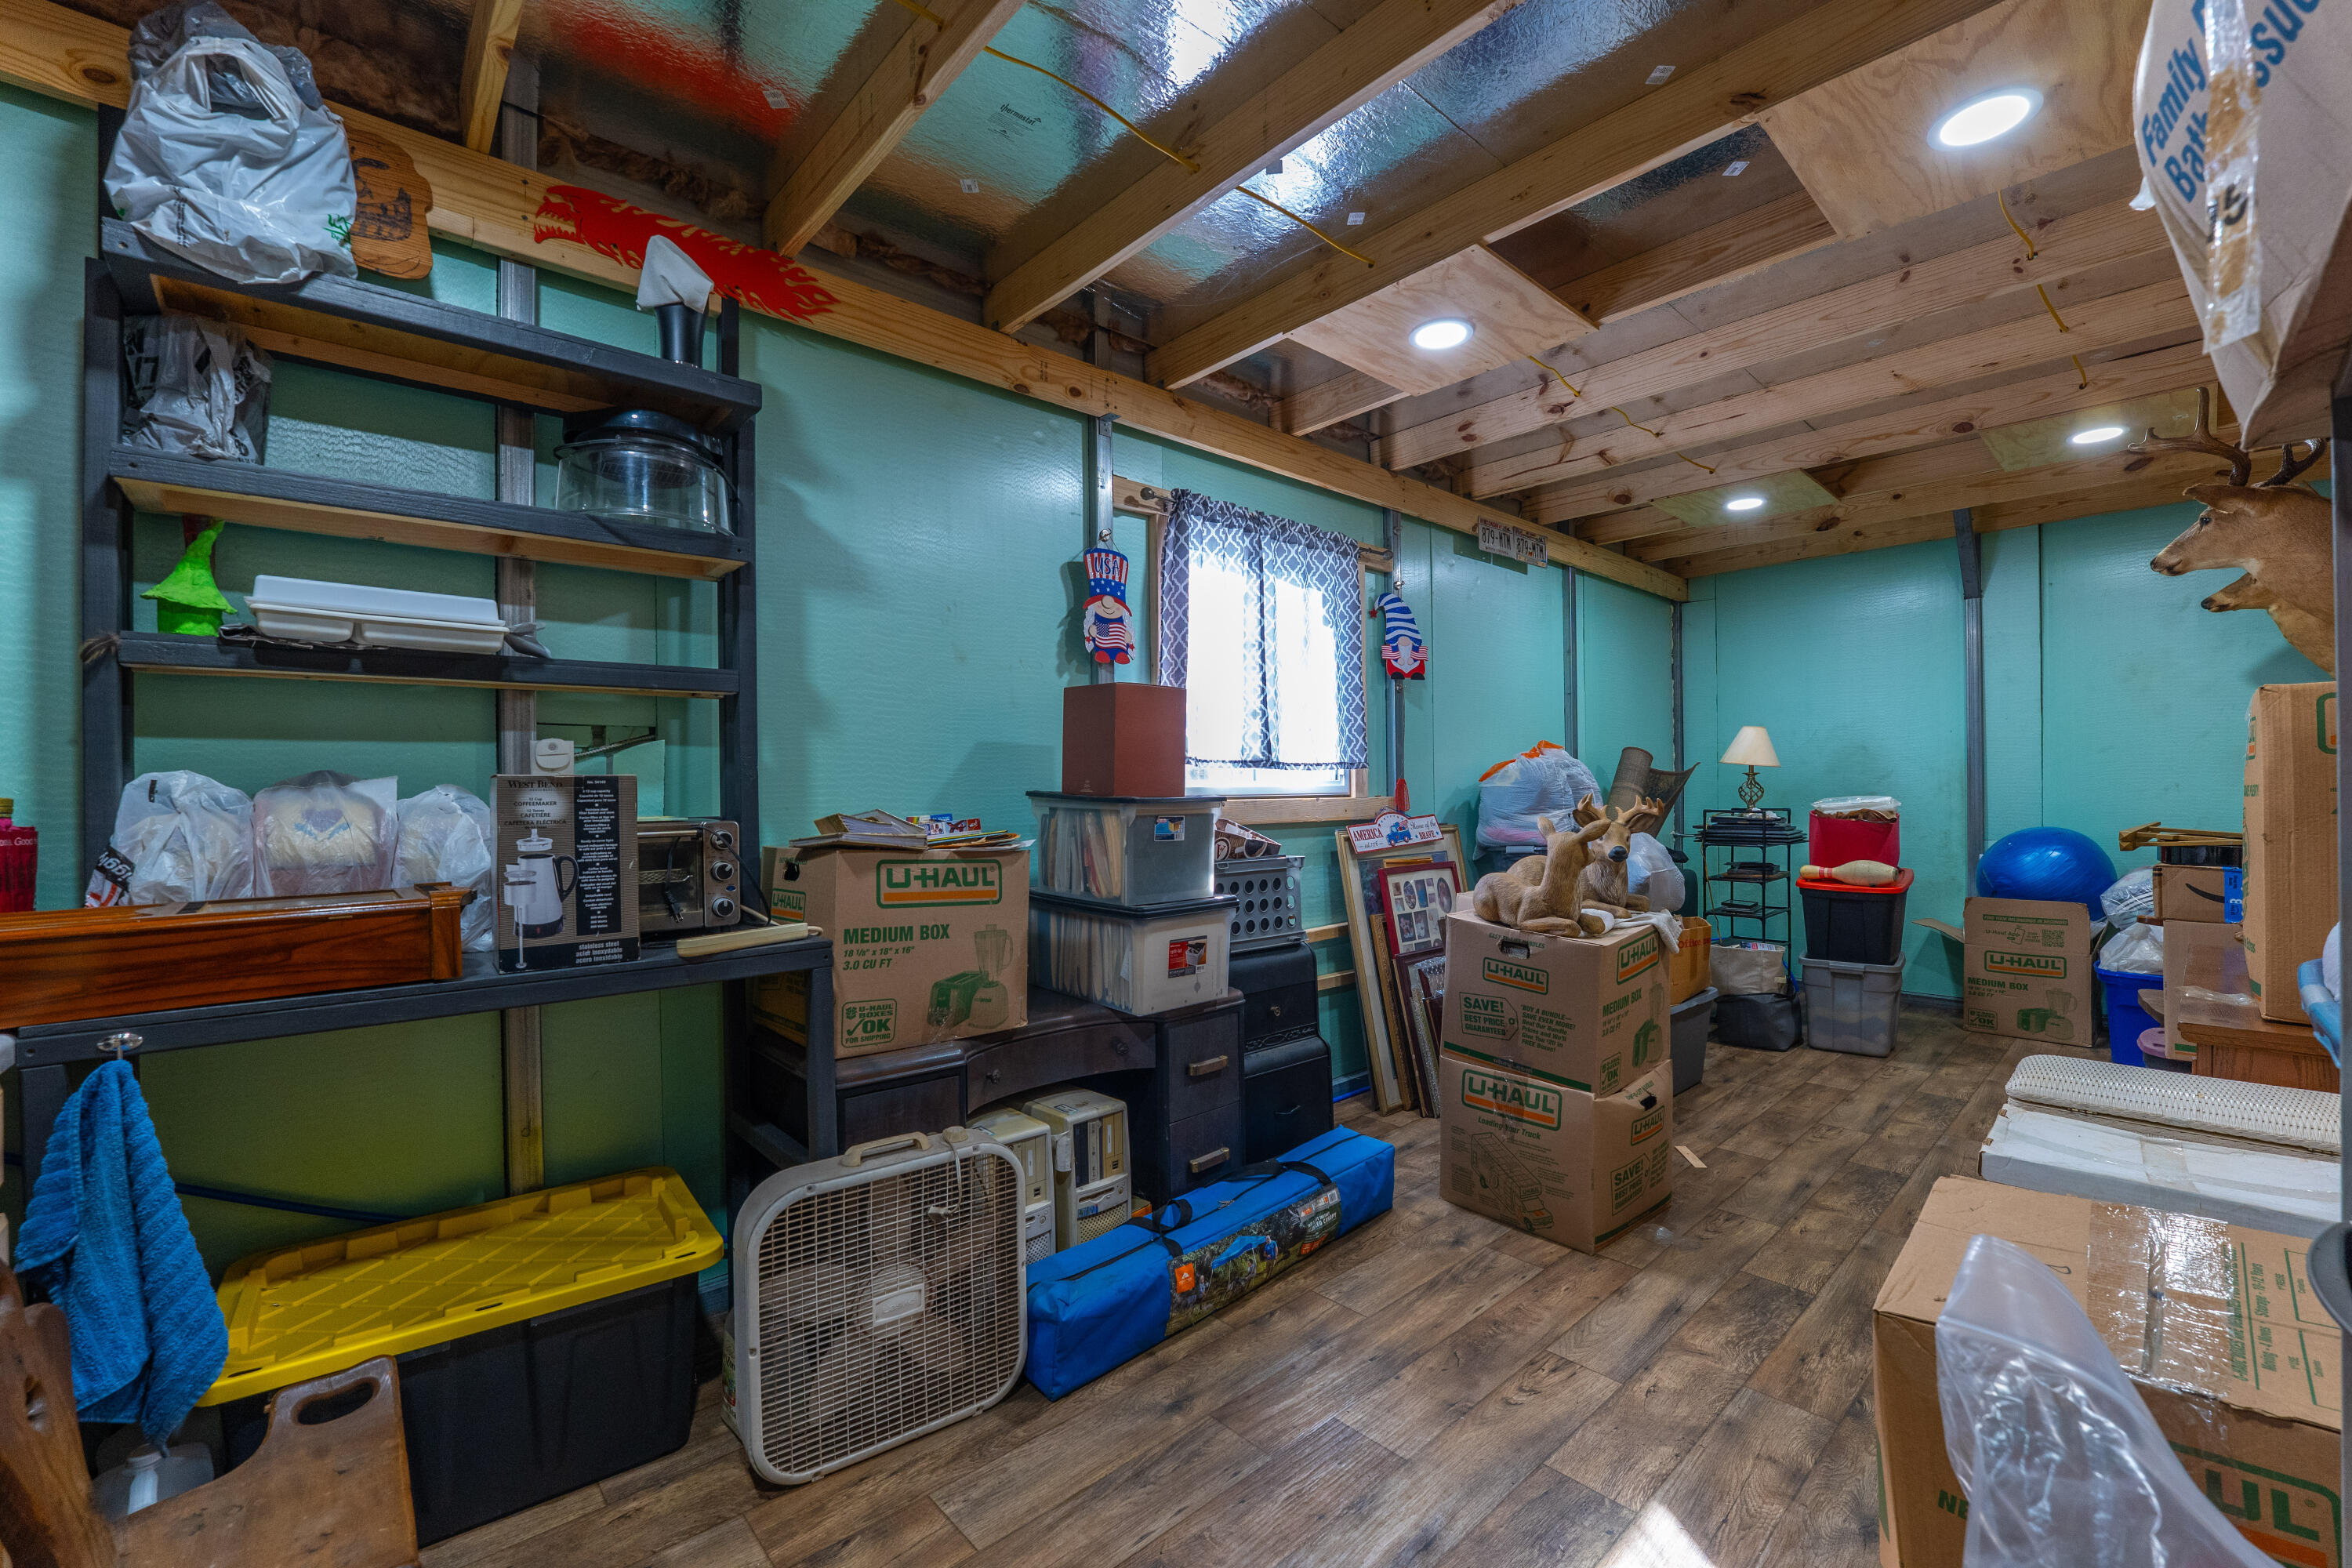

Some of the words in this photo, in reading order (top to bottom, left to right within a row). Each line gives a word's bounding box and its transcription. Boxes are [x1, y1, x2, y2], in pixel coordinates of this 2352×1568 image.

[2142, 38, 2206, 167] Family
[1094, 556, 1120, 576] USA
[508, 780, 534, 789] WEST
[1352, 827, 1385, 842] AMERICA
[1418, 829, 1436, 840] BRAVE
[886, 866, 995, 889] U-HAUL
[772, 892, 804, 911] U-HAUL
[844, 926, 914, 945] MEDIUM
[920, 924, 950, 940] BOX
[1621, 938, 1657, 969] U-HAUL
[1990, 954, 2062, 970] U-HAUL
[843, 960, 860, 971] 3.0
[862, 959, 877, 969] CU
[879, 958, 893, 968] FT
[1486, 961, 1544, 985] U-HAUL
[1968, 977, 2006, 988] MEDIUM
[2009, 982, 2029, 991] BOX
[858, 1003, 894, 1012] U-HAUL
[1463, 996, 1504, 1014] SAVE!
[1602, 994, 1629, 1018] MEDIUM
[1632, 987, 1642, 1004] BOX
[858, 1010, 893, 1019] BOXES
[1464, 1014, 1482, 1023] BEST
[1483, 1018, 1505, 1027] PRICE
[862, 1018, 891, 1034] OK
[845, 1036, 858, 1044] FOR
[860, 1033, 891, 1043] SHIPPING
[1607, 1067, 1619, 1082] OK
[1468, 1076, 1555, 1114] U-HAUL
[1478, 1116, 1504, 1130] Loading
[1521, 1127, 1541, 1140] Truck
[1634, 1109, 1663, 1136] U-HAUL
[1614, 1159, 1644, 1186] SAVE!
[1615, 1189, 1628, 1201] BEST
